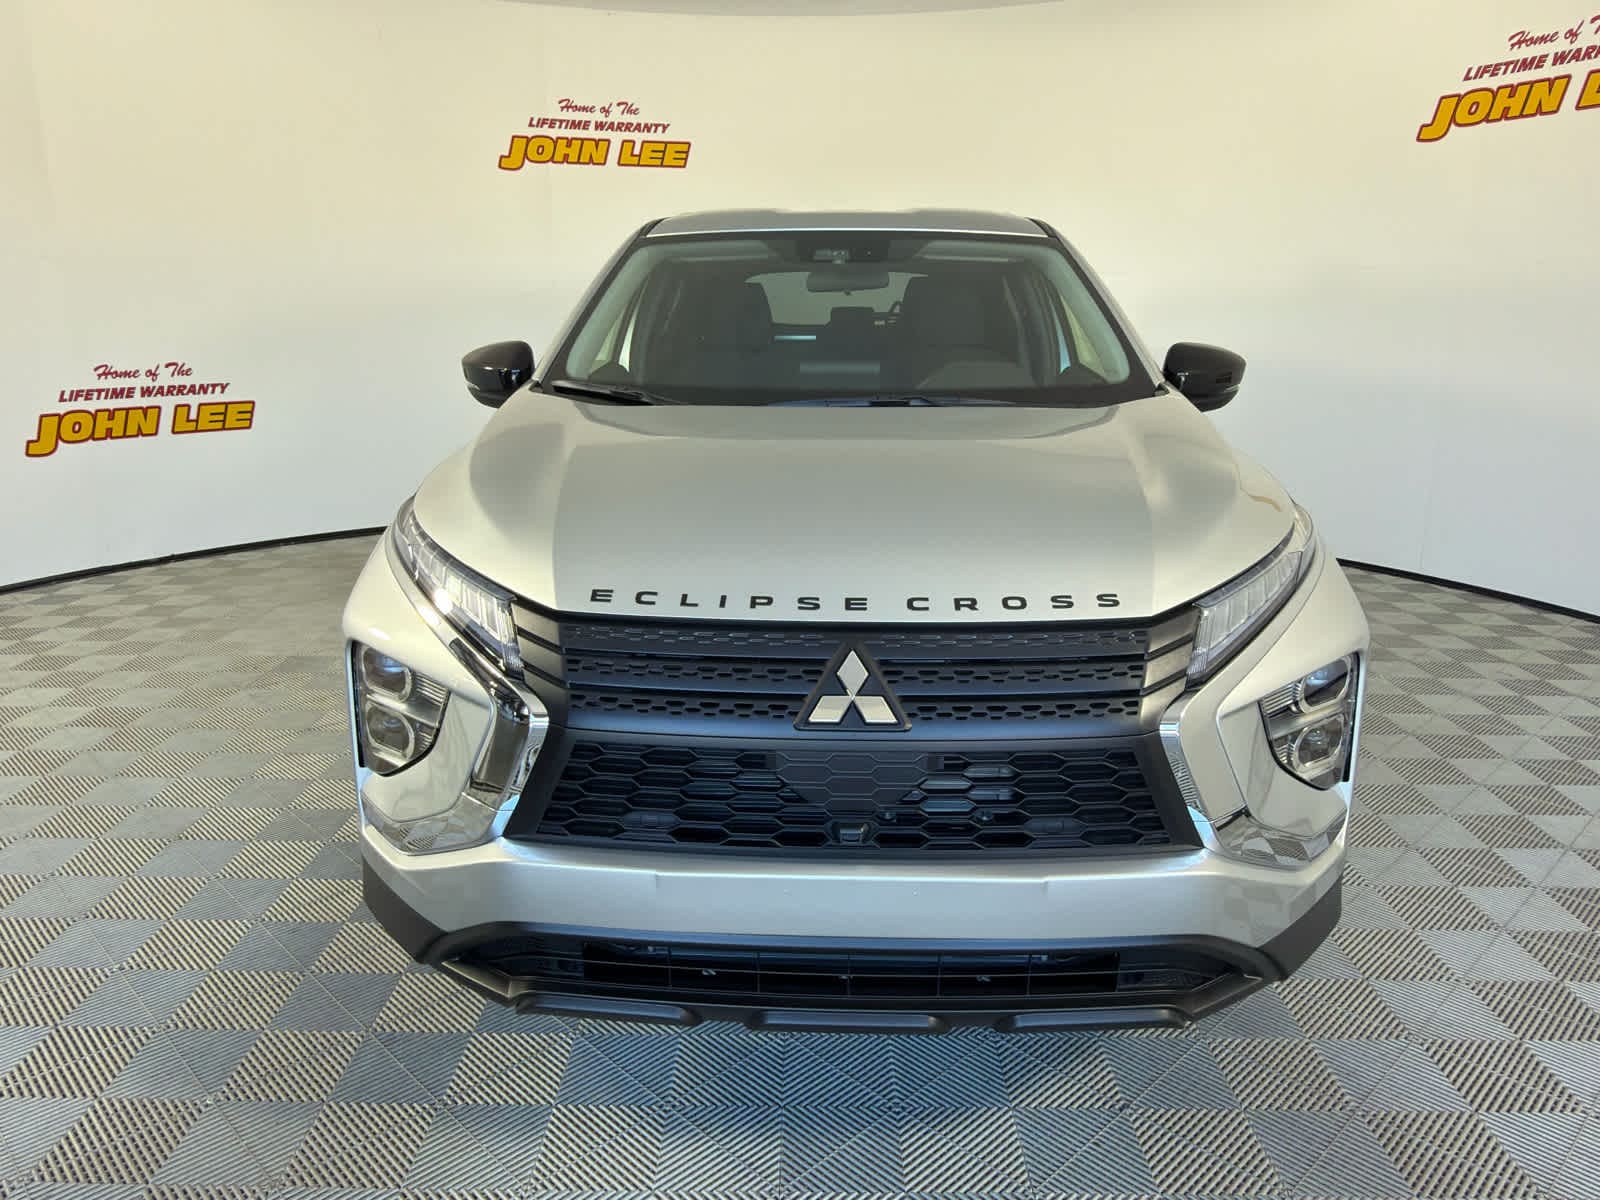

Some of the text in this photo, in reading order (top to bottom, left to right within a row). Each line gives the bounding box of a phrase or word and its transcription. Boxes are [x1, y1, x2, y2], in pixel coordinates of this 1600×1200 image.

[1508, 30, 1559, 50] Home
[1564, 20, 1584, 44] of
[1462, 53, 1549, 81] LIFETIME
[558, 99, 640, 117] Home of The
[1416, 74, 1572, 142] JOHN
[528, 117, 670, 134] LIFETIME WARRANTY
[498, 135, 691, 171] JOHN LEE
[94, 362, 192, 382] Home of The
[58, 382, 231, 403] LIFETIME WARRANTY
[25, 400, 255, 457] JOHN LEE
[590, 588, 1121, 611] ECLIPSE CROSS
